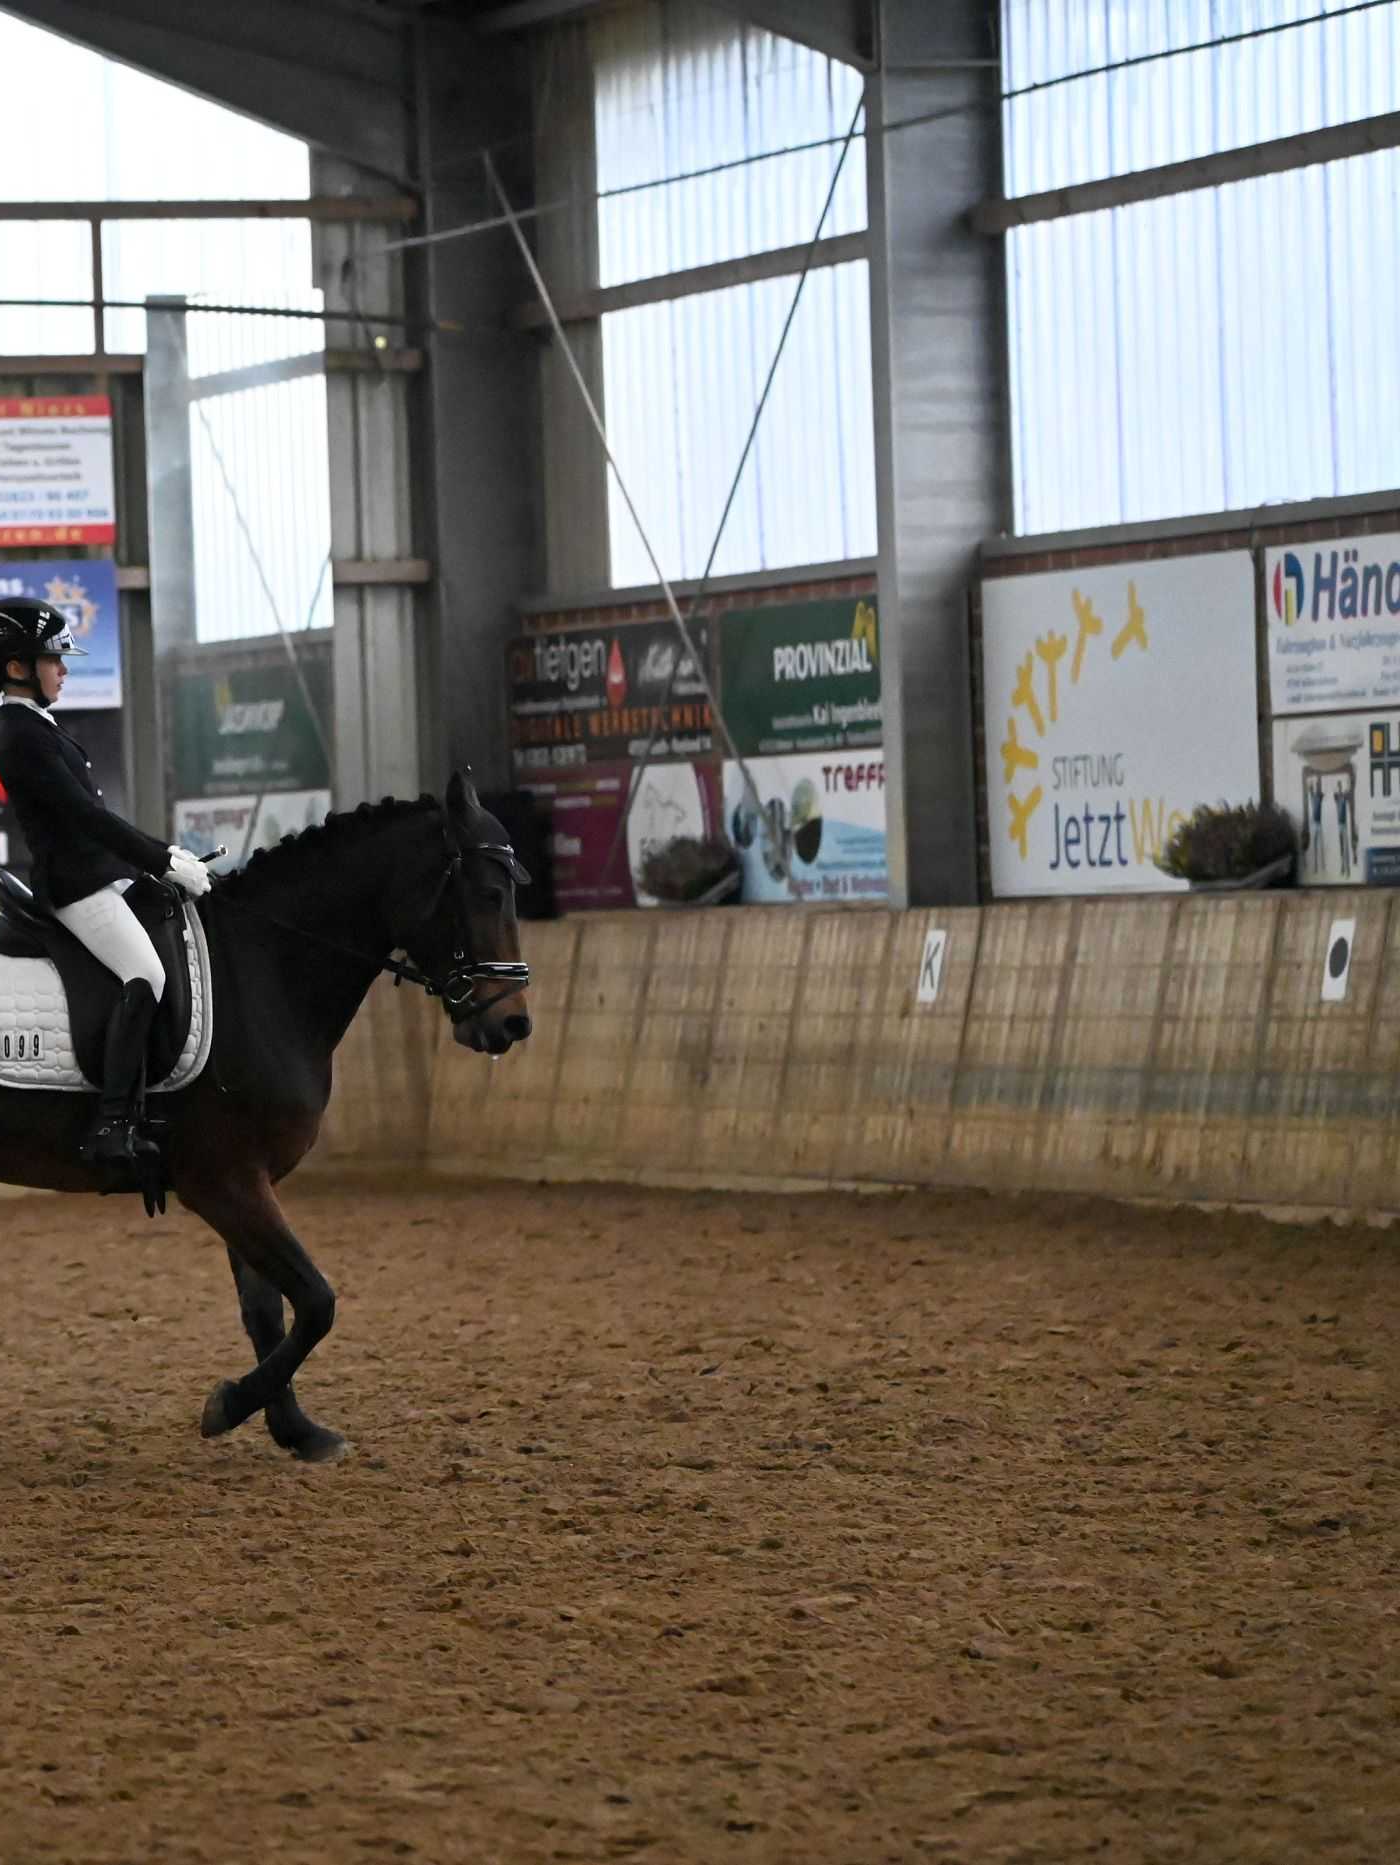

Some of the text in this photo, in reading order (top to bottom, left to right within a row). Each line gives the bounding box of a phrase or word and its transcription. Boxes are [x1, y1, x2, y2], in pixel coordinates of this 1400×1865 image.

[773, 638, 873, 683] PROVINZIAL
[1052, 753, 1126, 792] STIFTUNG
[921, 941, 941, 989] K
